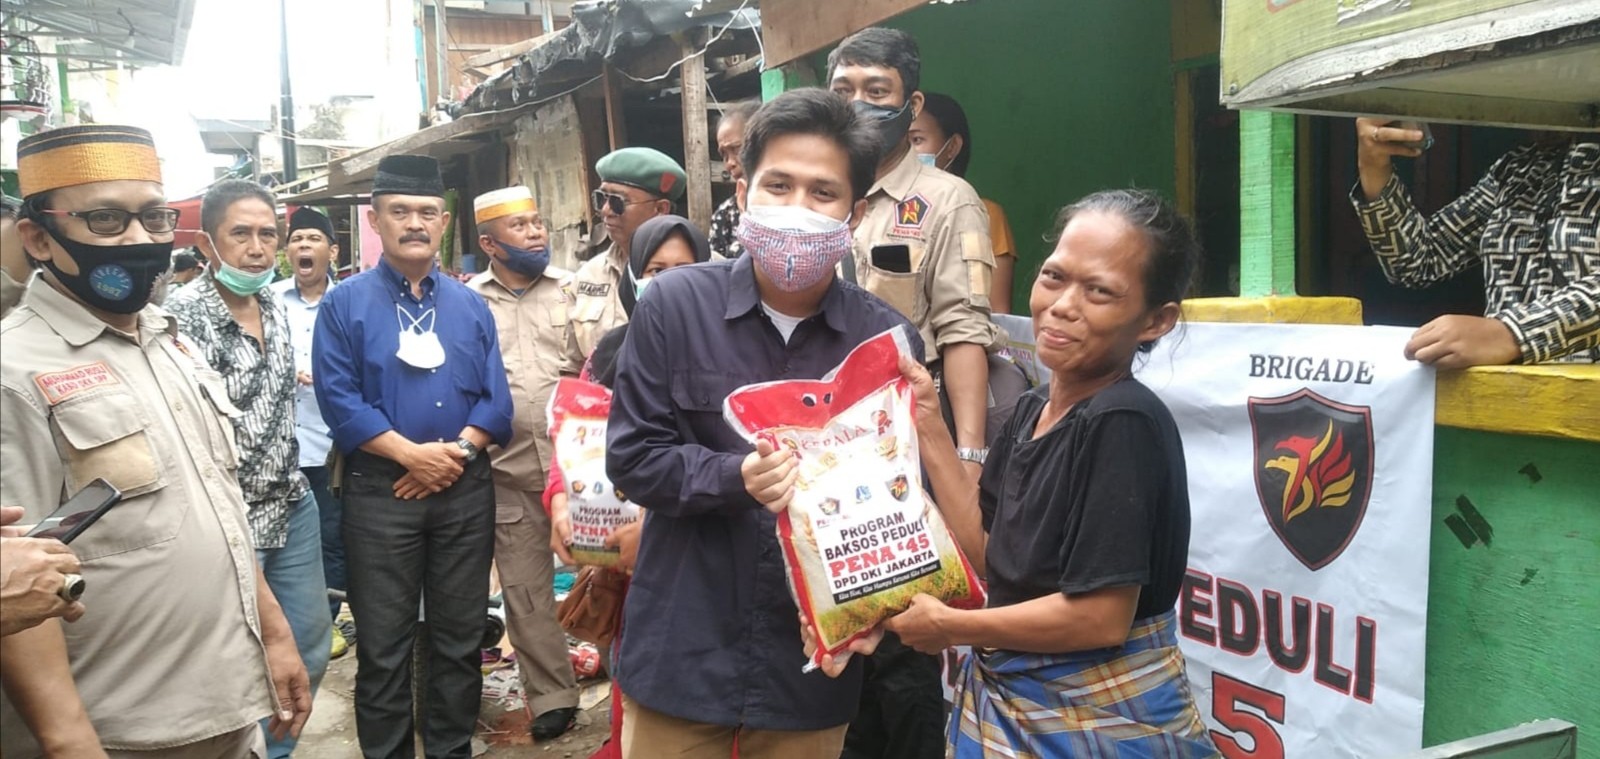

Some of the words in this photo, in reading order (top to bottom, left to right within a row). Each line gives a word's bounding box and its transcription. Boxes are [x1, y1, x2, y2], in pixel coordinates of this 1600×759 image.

[1249, 354, 1375, 385] BRIGADE
[579, 506, 621, 516] PROGRAM
[603, 515, 637, 526] PEDULI
[840, 511, 905, 541] PROGRAM
[573, 523, 609, 537] PENA
[824, 534, 879, 560] BAKSOS
[881, 519, 926, 543] PEDULI
[828, 545, 896, 578] PENA
[897, 532, 930, 553] '45
[833, 575, 858, 589] DPD
[861, 570, 882, 582] DKI
[885, 549, 935, 574] JAKARTA
[1179, 568, 1377, 704] EDULI
[1209, 670, 1286, 759] 5
